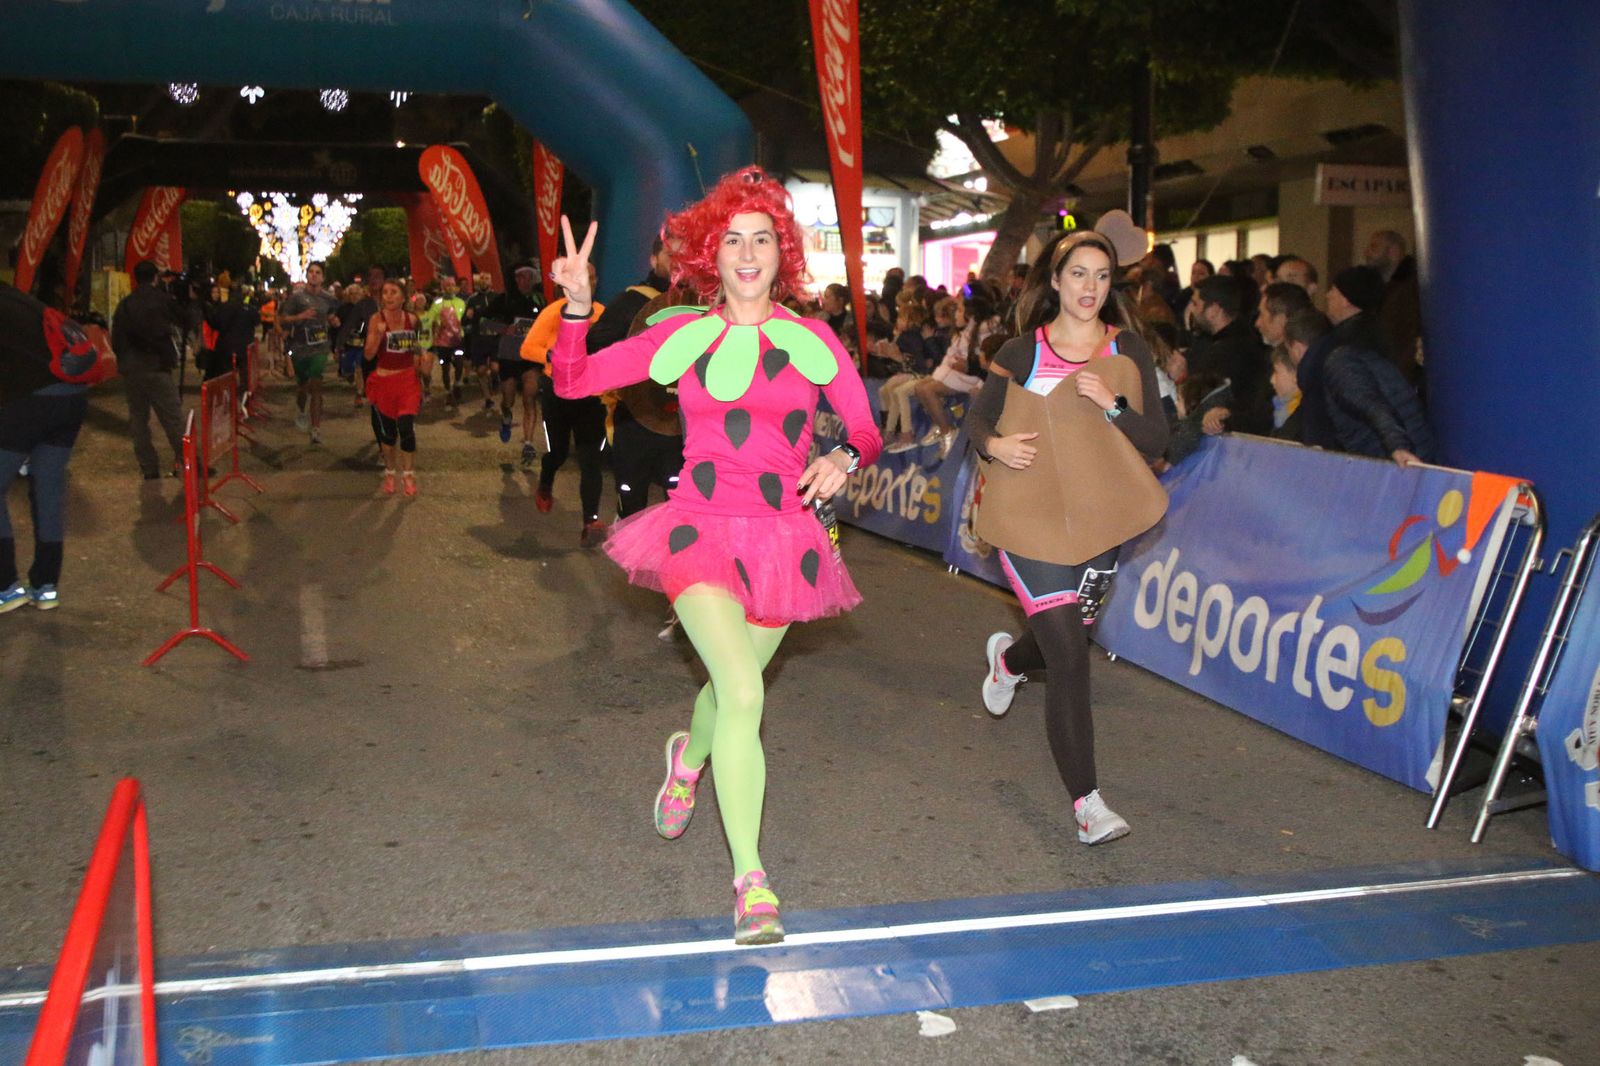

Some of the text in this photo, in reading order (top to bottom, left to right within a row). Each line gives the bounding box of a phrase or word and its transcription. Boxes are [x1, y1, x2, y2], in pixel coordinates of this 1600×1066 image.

[269, 4, 322, 23] CAJA
[330, 5, 396, 26] RURAL
[836, 462, 942, 525] eportes
[1133, 547, 1407, 727] deportes
